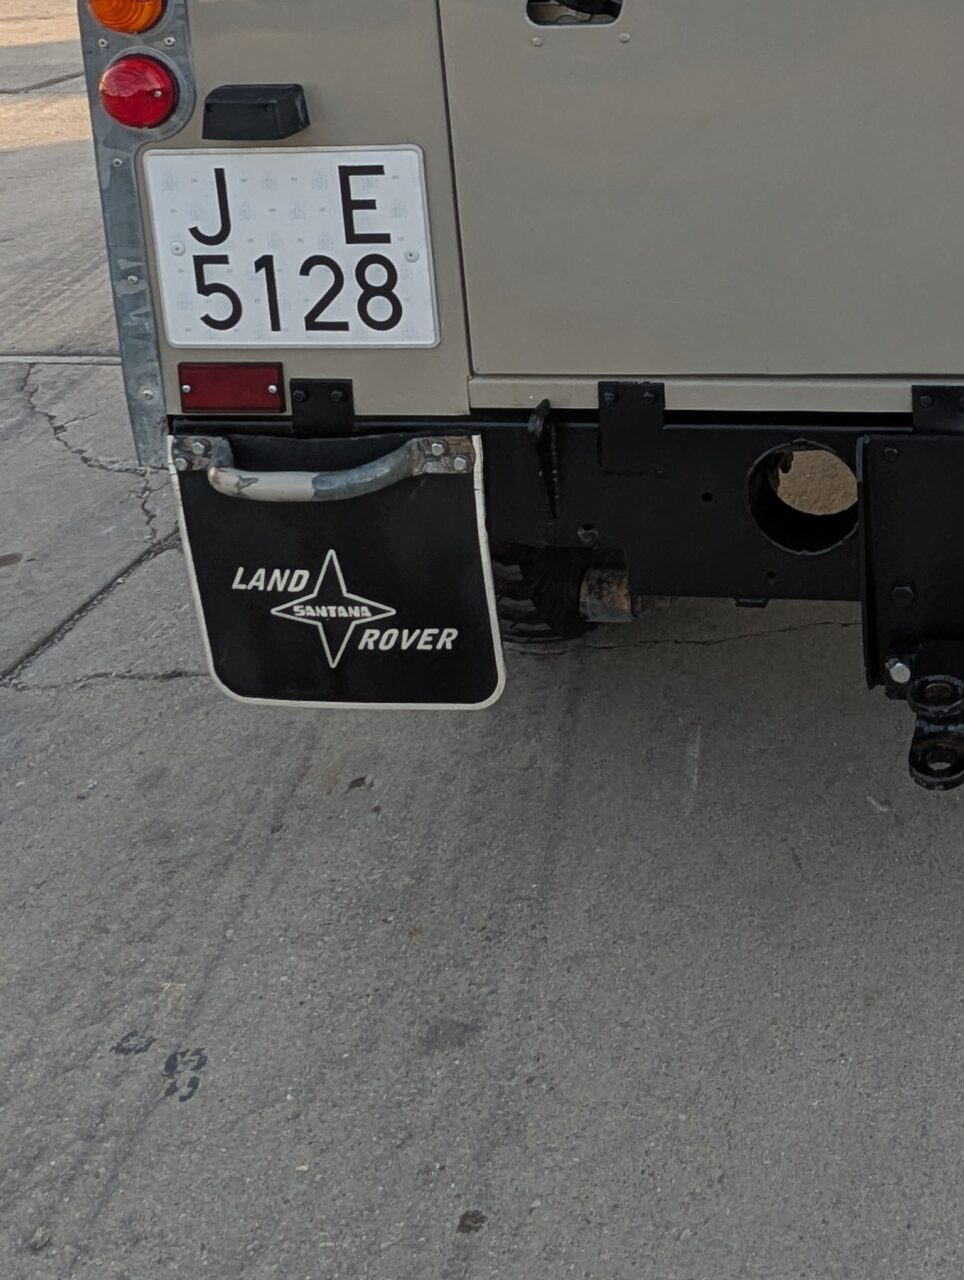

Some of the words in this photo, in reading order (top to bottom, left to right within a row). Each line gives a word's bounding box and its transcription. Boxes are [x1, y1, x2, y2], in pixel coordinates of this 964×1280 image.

[188, 167, 232, 246] J
[338, 164, 392, 245] E
[192, 253, 403, 332] 5128
[231, 566, 310, 593] LAND
[293, 604, 373, 618] SANTANA
[357, 627, 459, 651] ROVER
